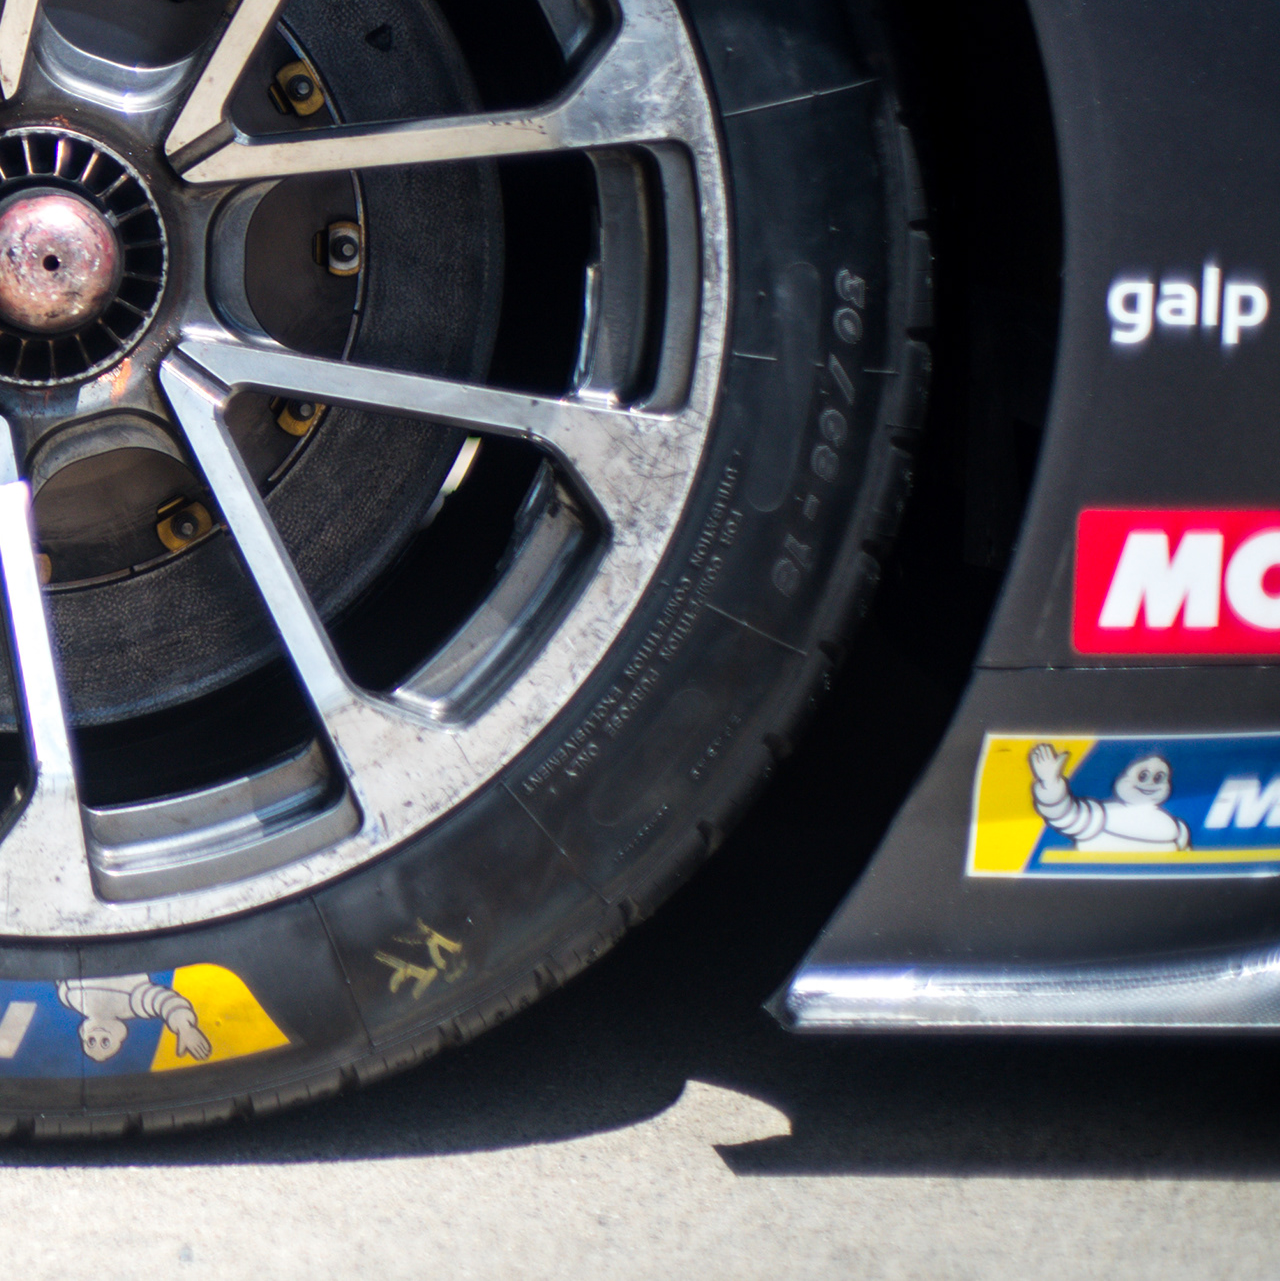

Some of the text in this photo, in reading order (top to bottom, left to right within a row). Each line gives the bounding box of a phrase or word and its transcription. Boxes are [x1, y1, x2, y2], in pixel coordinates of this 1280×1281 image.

[1106, 262, 1269, 346] galp
[716, 506, 745, 548] FOR
[516, 464, 739, 796] UTILISATION COMPETITION EXCLUSIVEMENT
[656, 552, 726, 663] COMPETITION
[600, 664, 662, 739] PURPOSE
[559, 739, 602, 783] ONLY
